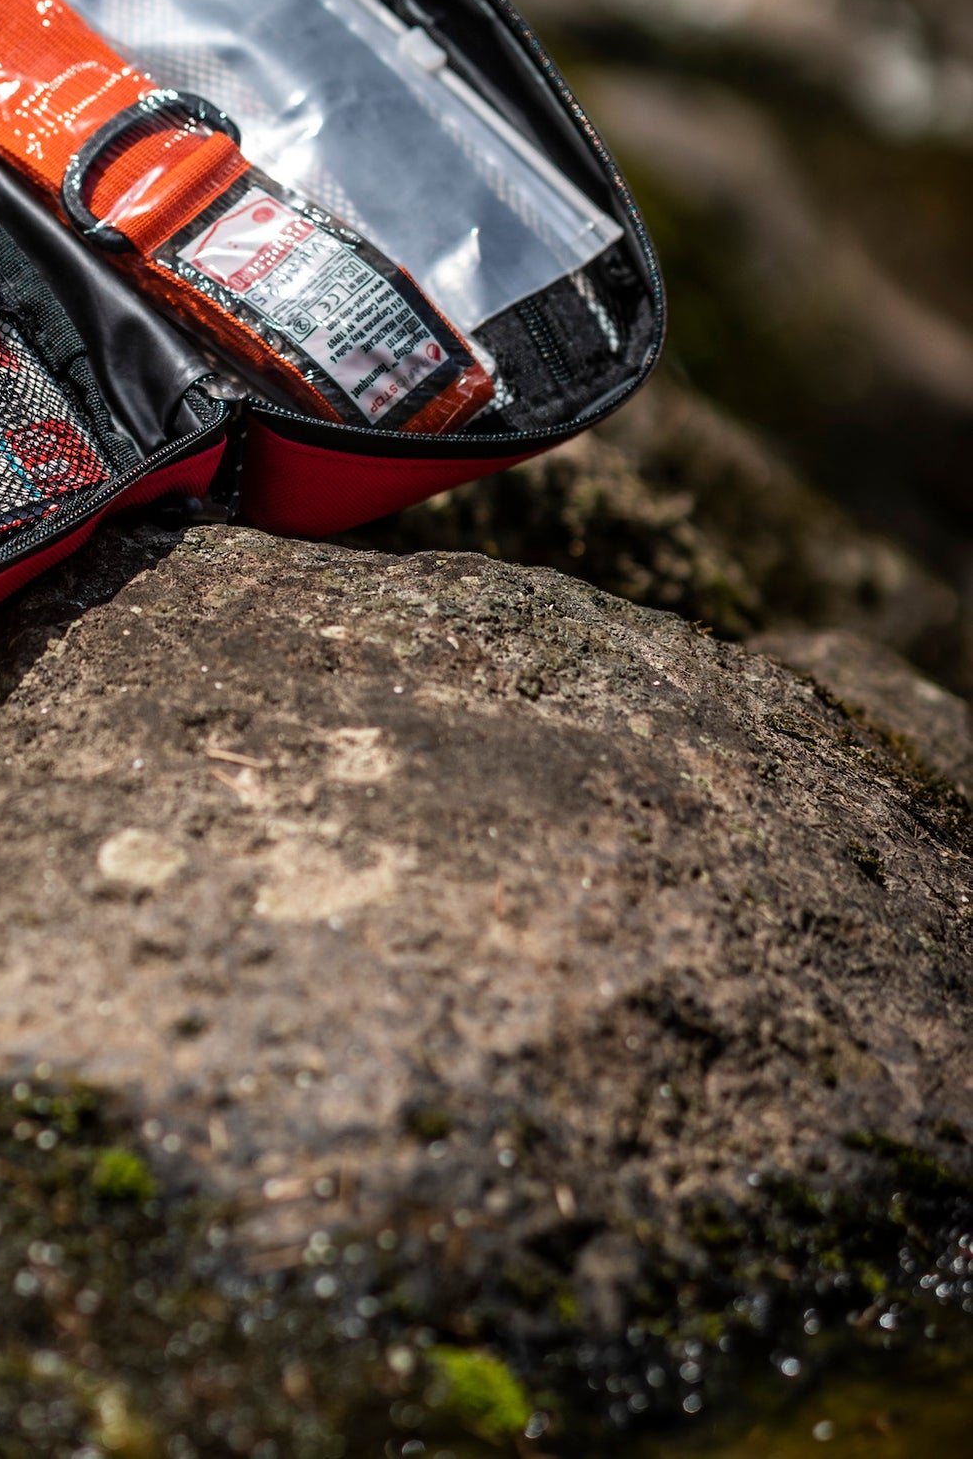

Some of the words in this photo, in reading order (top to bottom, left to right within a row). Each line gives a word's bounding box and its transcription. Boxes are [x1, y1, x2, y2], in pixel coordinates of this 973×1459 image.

[335, 259, 360, 284] USA
[362, 305, 393, 333] Corporate
[395, 307, 411, 323] AERO
[360, 320, 397, 352] HEALTHCARE
[335, 342, 352, 358] Suite
[350, 362, 389, 399] Tourniquet
